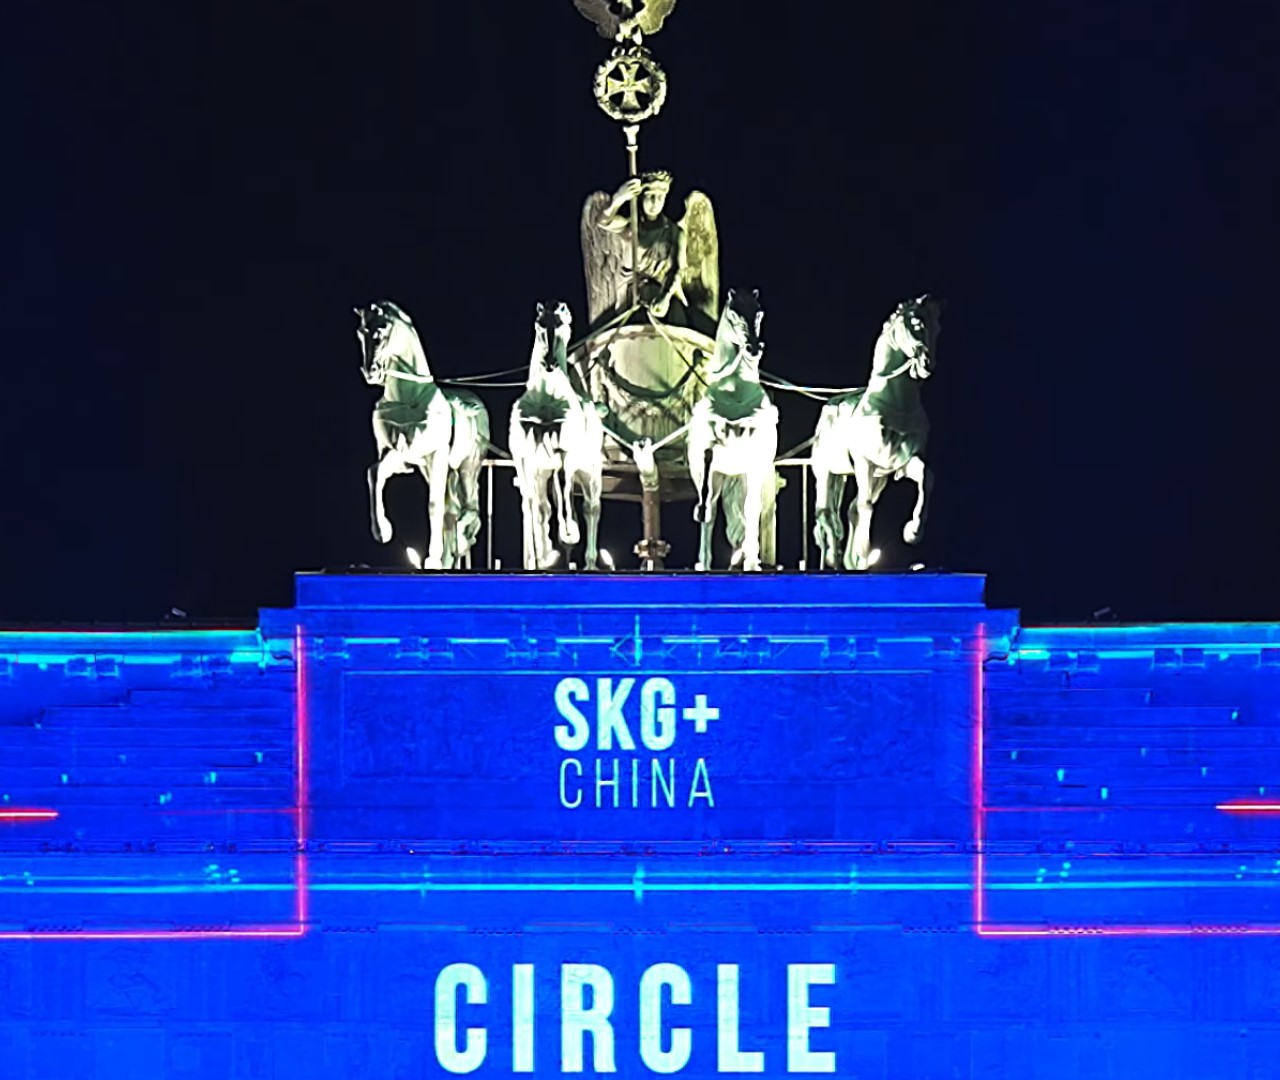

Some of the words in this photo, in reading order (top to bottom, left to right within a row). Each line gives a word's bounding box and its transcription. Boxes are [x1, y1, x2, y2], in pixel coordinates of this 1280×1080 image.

[554, 677, 720, 751] SKG+
[560, 758, 714, 808] CHINA
[434, 962, 836, 1073] CIRCLE
